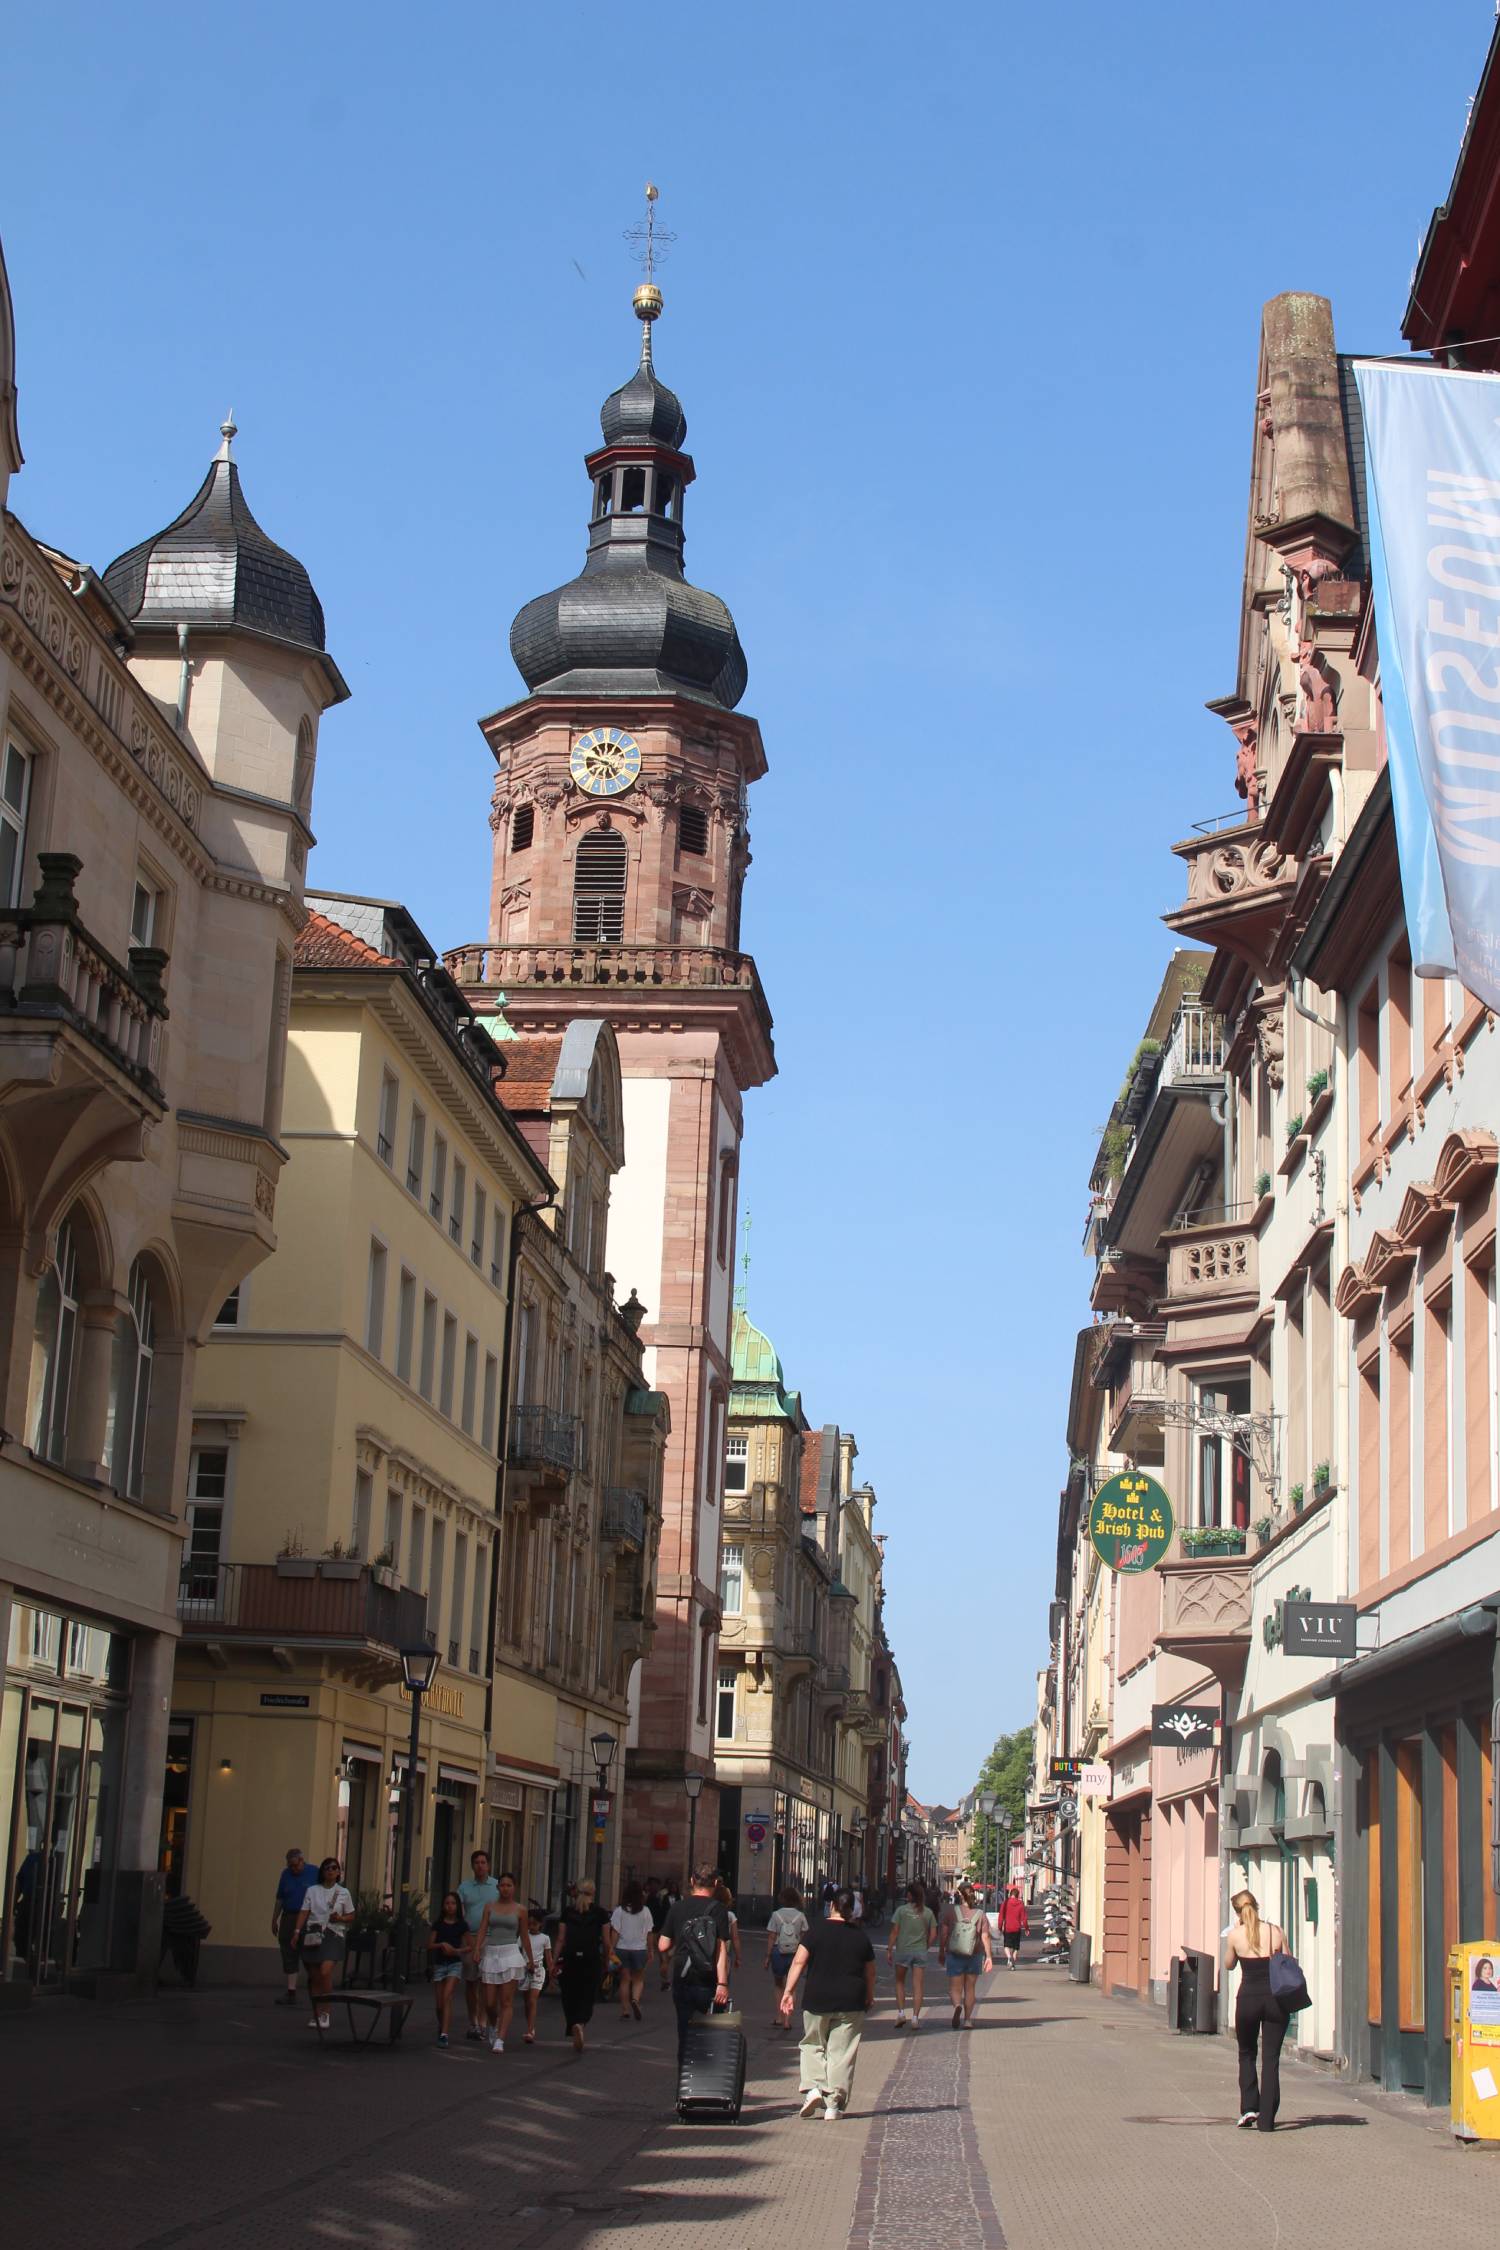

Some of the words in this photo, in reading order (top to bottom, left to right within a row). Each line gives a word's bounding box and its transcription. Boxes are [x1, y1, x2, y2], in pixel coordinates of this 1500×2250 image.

[1102, 1502, 1145, 1521] Hotel
[1150, 1508, 1163, 1522] &
[1094, 1519, 1132, 1538] Irish
[1136, 1522, 1166, 1541] Pub
[1299, 1616, 1343, 1634] VIU
